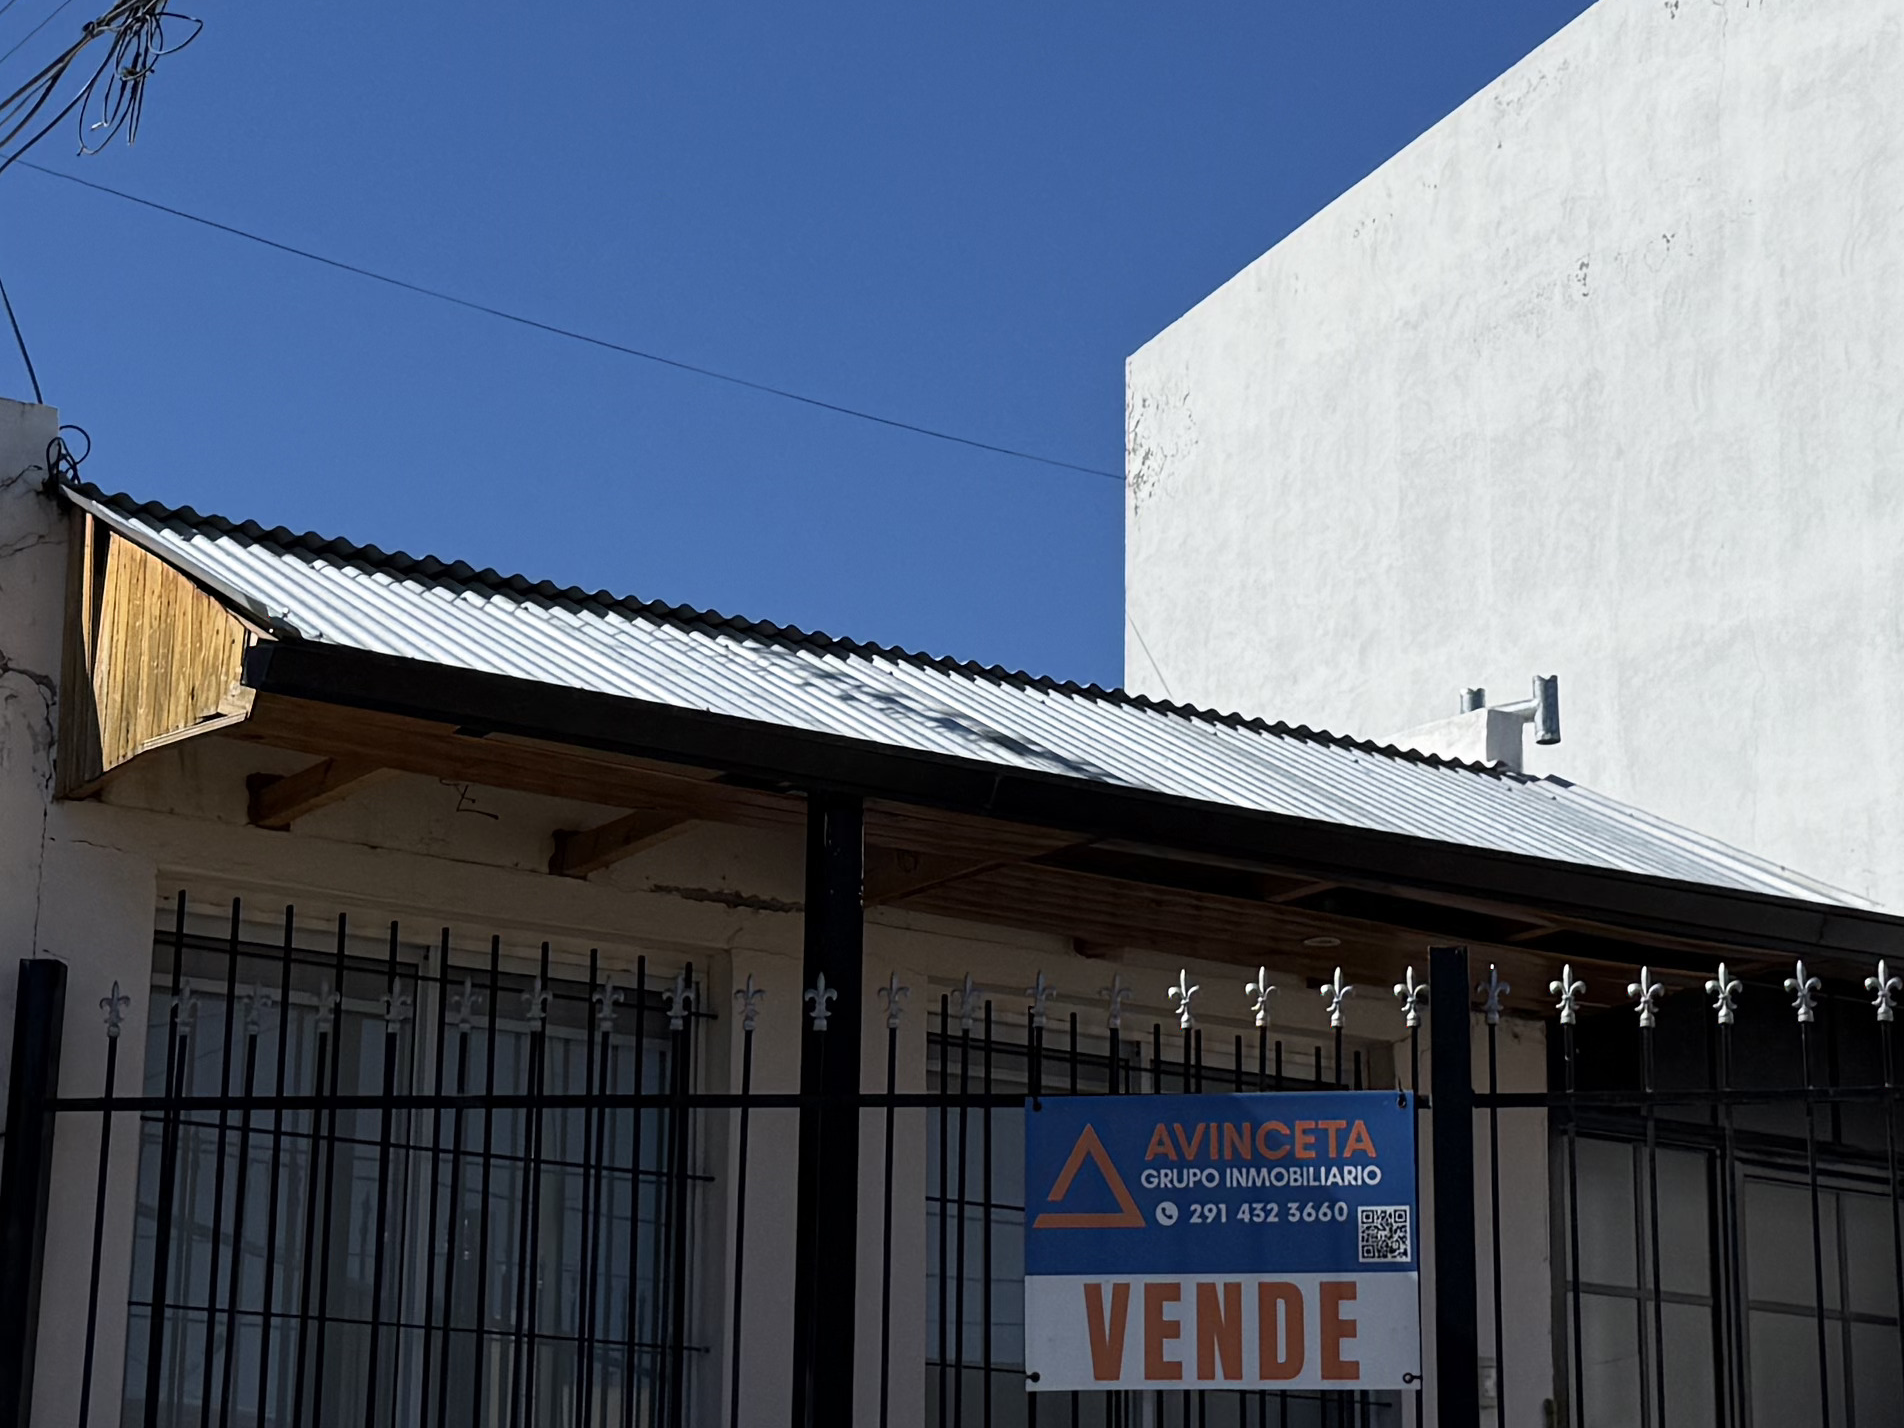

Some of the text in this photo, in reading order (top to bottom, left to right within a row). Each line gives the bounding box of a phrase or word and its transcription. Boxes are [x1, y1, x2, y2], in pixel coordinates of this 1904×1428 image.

[1144, 1119, 1378, 1162] AVINCETA
[1140, 1165, 1382, 1189] GRUPO INMOBILIARIO
[1189, 1201, 1349, 1224] 291 432 3660
[1083, 1281, 1361, 1381] VENDE
